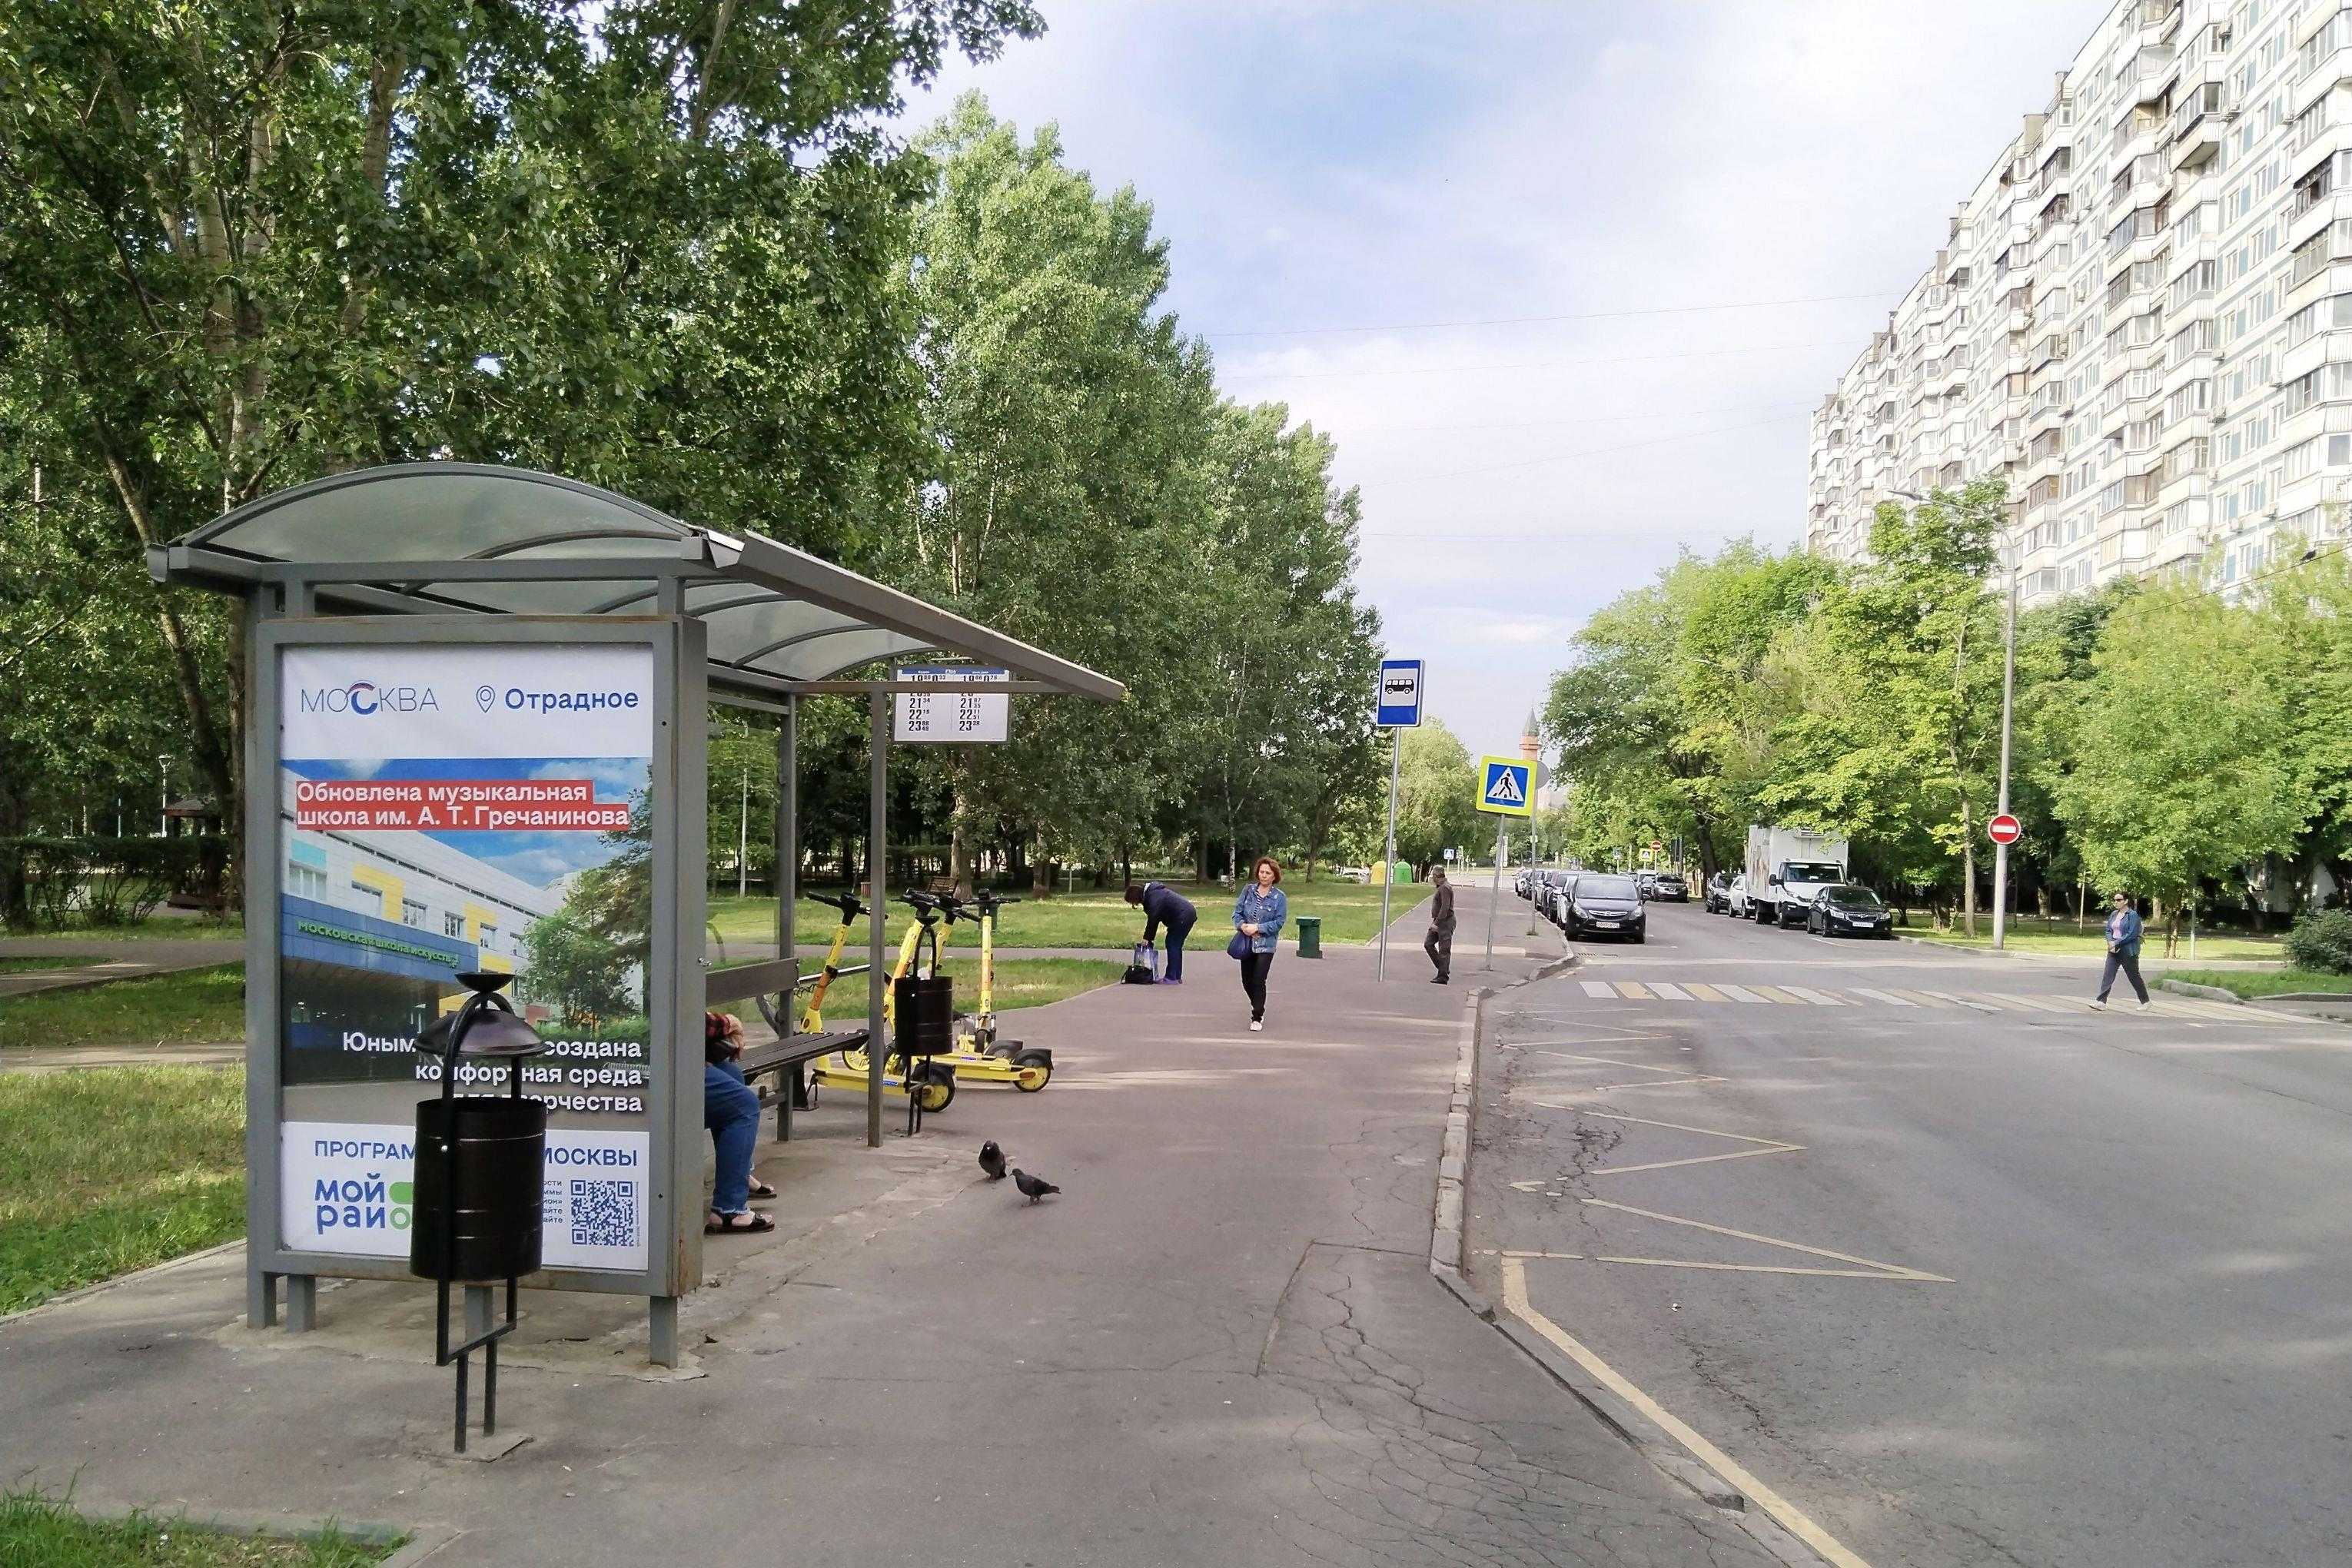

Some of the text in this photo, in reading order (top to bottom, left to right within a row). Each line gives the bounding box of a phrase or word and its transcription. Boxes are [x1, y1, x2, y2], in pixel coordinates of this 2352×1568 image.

[301, 679, 440, 714] МОСКВА
[505, 688, 639, 713] Отрадное
[909, 697, 922, 708] 21
[960, 697, 972, 708] 21
[909, 709, 922, 719] 22
[959, 709, 972, 719] 22
[909, 721, 922, 731] 23
[958, 721, 972, 731] 23
[297, 783, 587, 806] Обновлена музыкальная
[297, 807, 630, 829] школа им. А. Т. Гречанинова
[543, 1040, 643, 1059] создана
[415, 1062, 643, 1088] кофорная среда
[314, 1140, 416, 1160] ПРОГРАМ
